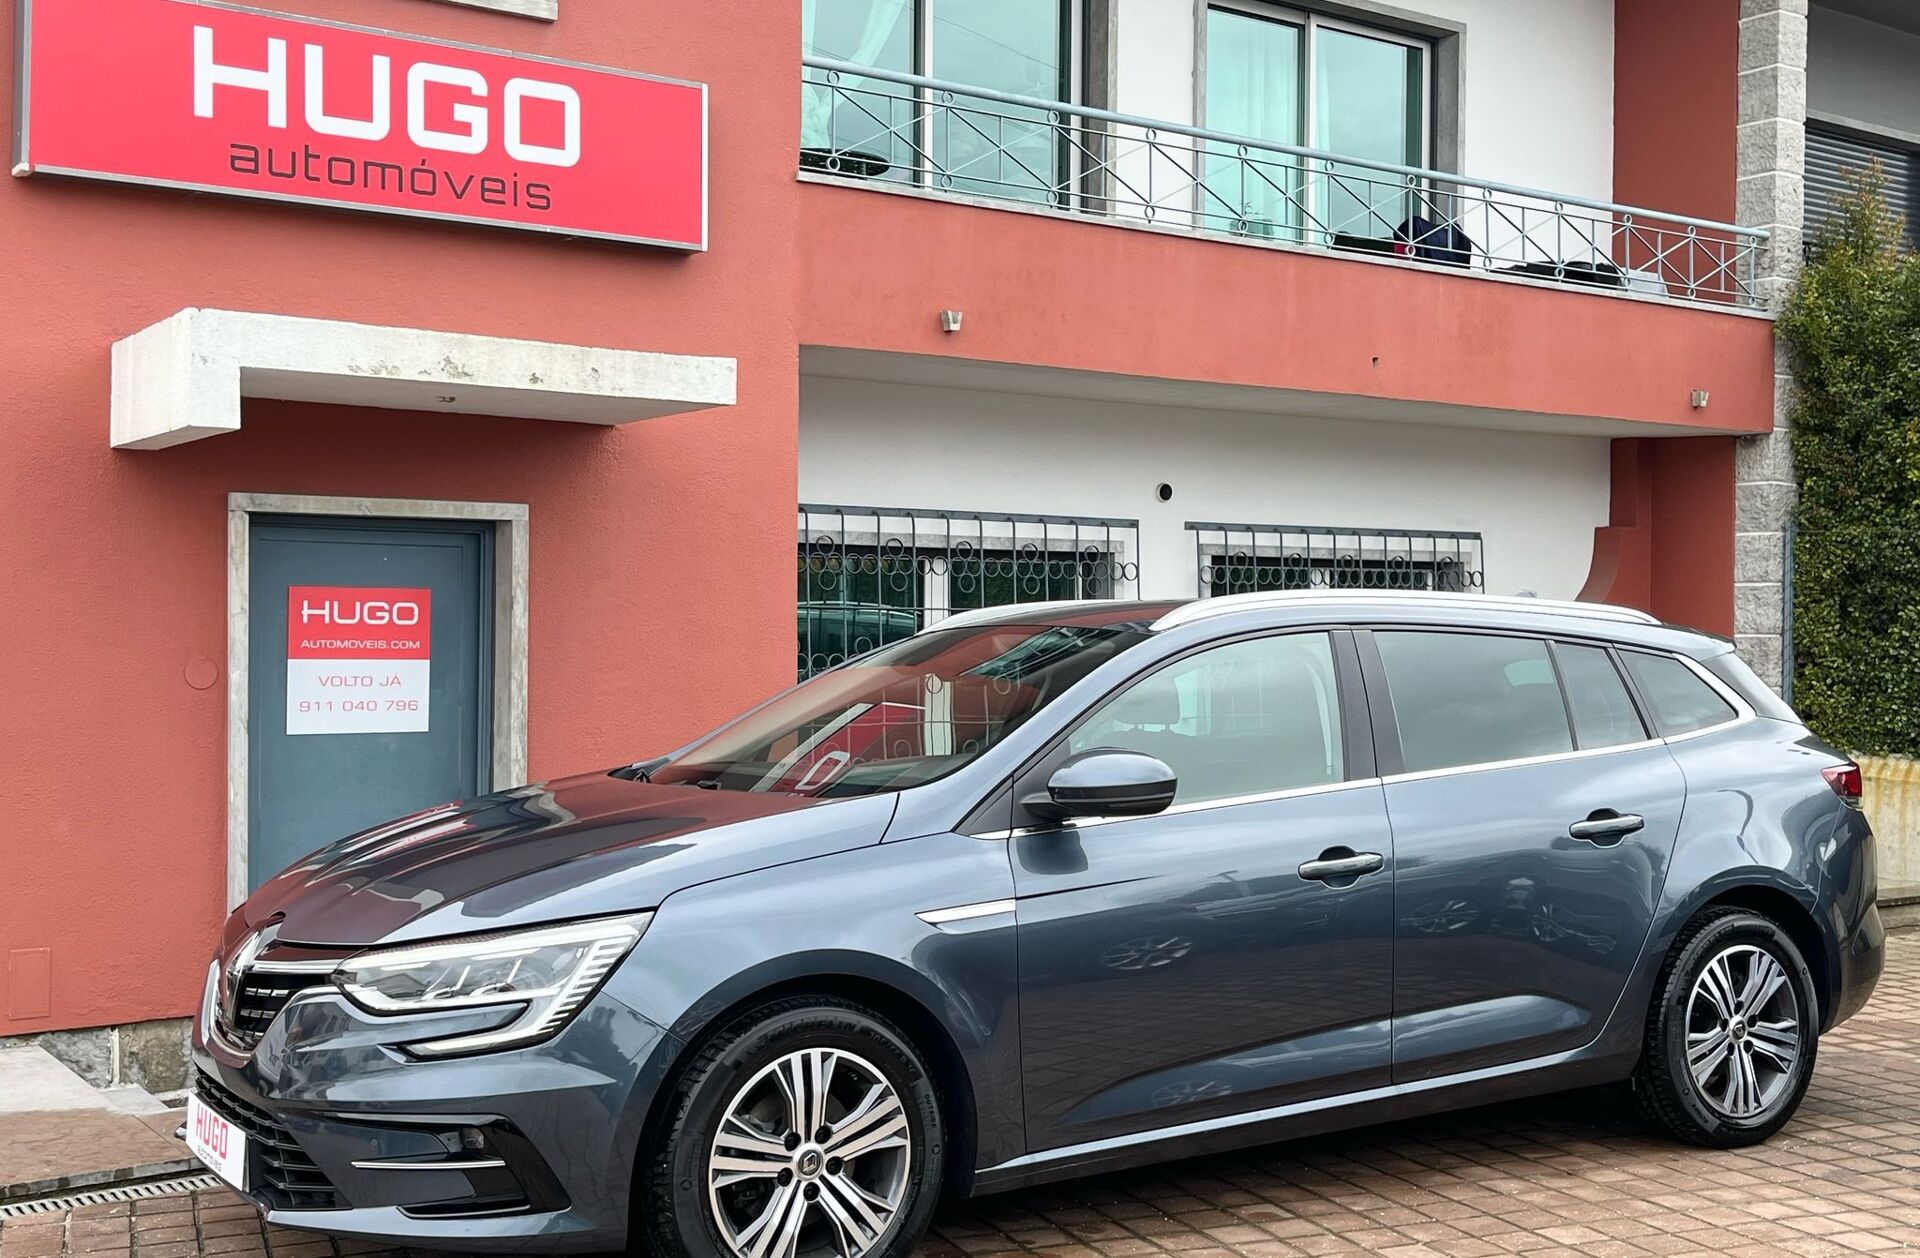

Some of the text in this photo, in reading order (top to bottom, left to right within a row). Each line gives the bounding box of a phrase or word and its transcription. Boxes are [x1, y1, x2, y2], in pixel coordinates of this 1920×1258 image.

[193, 25, 581, 168] HUGO
[230, 143, 552, 210] automóveis
[301, 600, 419, 625] HUGO
[301, 640, 420, 649] AUTOMOVEIS.COM
[318, 673, 402, 687] VOLTO JÁ
[299, 700, 418, 712] 911 040 796
[196, 1104, 228, 1159] HUGO
